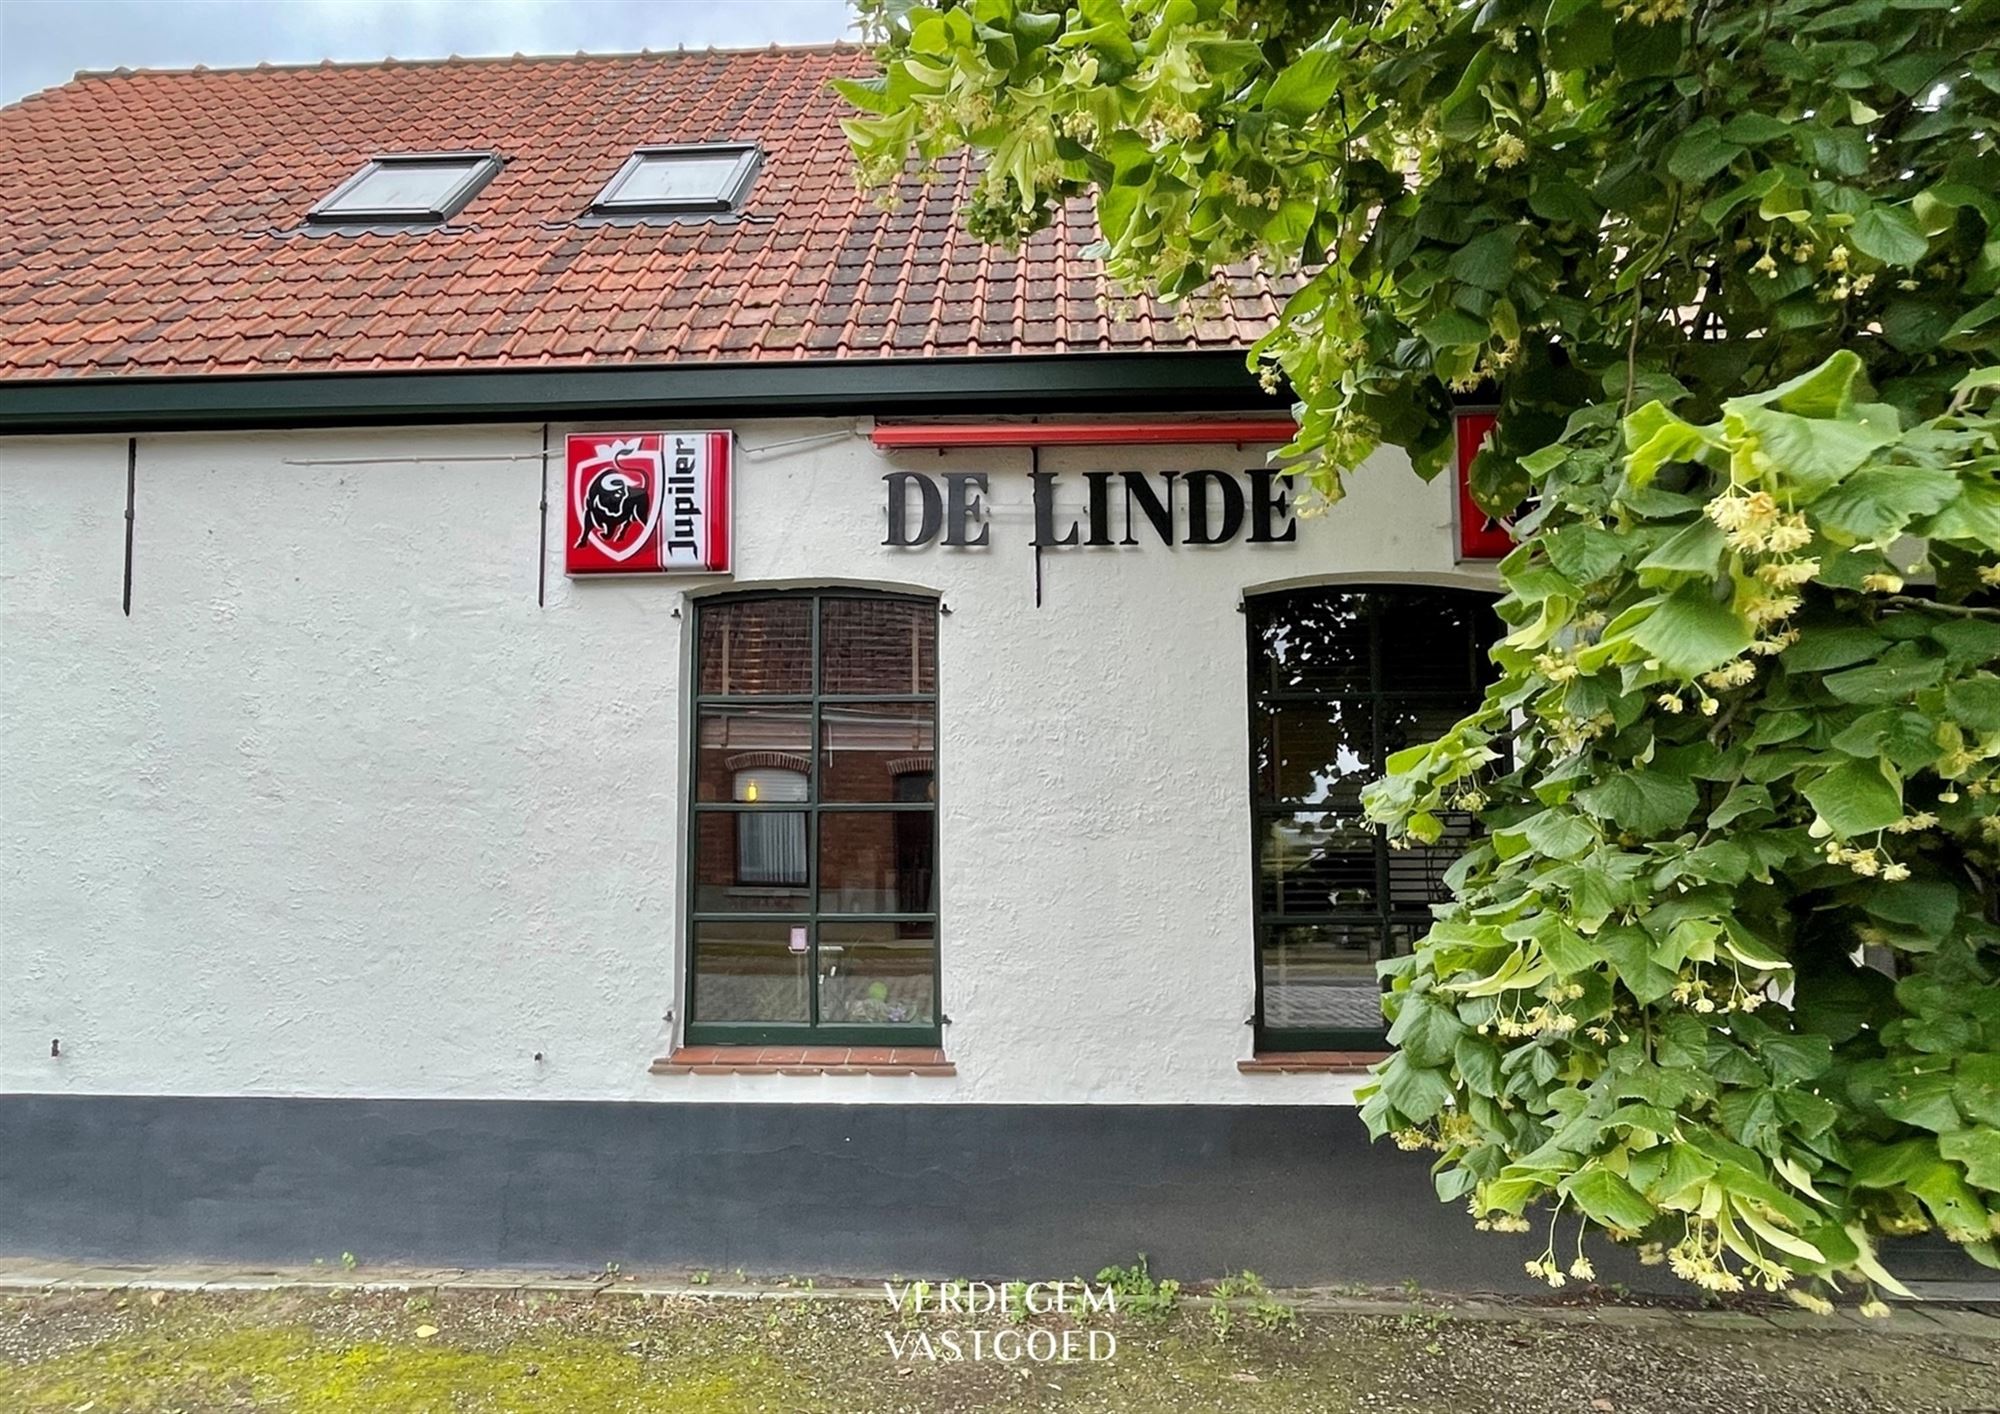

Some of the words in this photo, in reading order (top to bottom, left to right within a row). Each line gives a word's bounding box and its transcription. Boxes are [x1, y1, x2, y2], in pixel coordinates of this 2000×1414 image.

[668, 438, 702, 560] Jupiler
[881, 471, 989, 547] DE
[1027, 469, 1297, 547] LINDE
